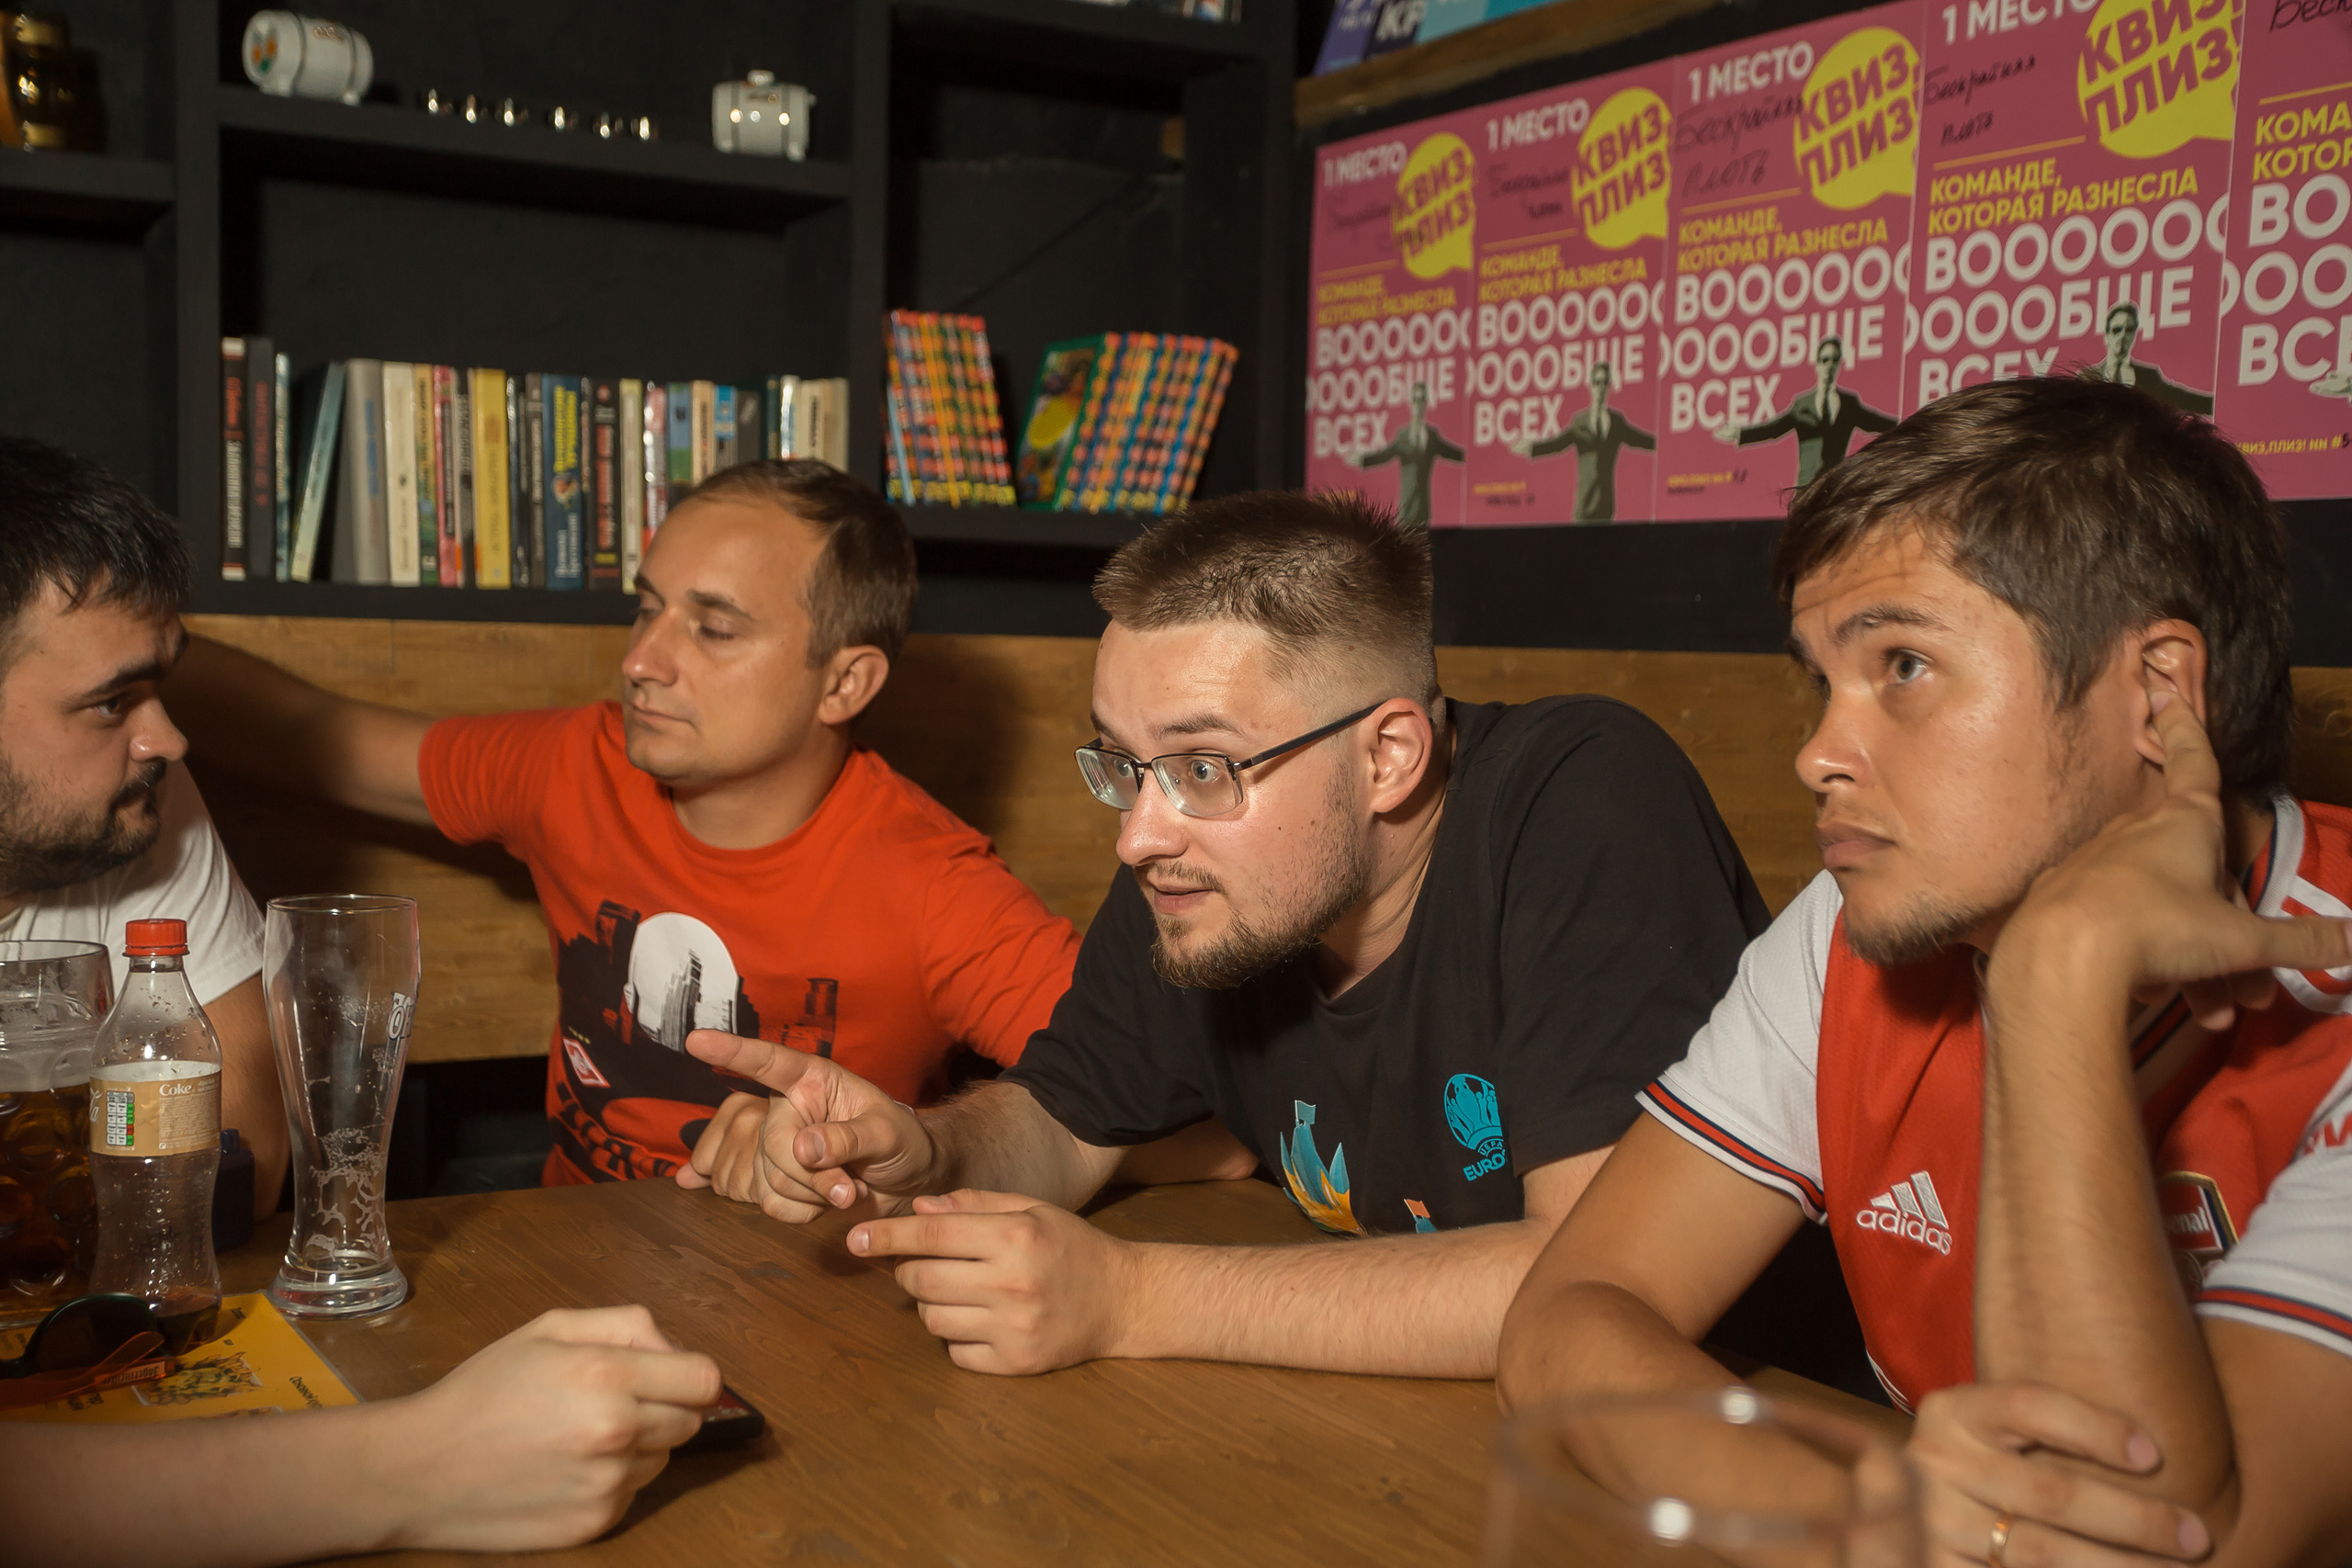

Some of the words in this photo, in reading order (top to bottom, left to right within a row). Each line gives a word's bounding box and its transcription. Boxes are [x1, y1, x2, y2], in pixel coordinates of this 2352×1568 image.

[1942, 5, 1957, 44] 1
[1690, 67, 1702, 103] 1
[1707, 41, 1815, 100] МЕСТО
[1486, 118, 1499, 152] 1
[1501, 97, 1590, 149] МЕСТО
[2256, 100, 2352, 147] КОМА
[1336, 141, 1408, 186] МЕСТО
[1930, 157, 2063, 205] КОМАНДЕ,
[1929, 191, 2045, 235] КОТОРАЯ
[2052, 165, 2199, 217] РАЗНЕСЛА
[1677, 234, 1770, 272] КОТОРАЯ
[1774, 217, 1889, 259] РАЗНЕСЛА
[1679, 205, 1782, 245] КОМАНДЕ,
[1475, 394, 1564, 446] ВСЕХ
[1670, 373, 1781, 433] ВСЕХ
[1314, 411, 1389, 457] ВСЕХ
[159, 1083, 192, 1097] Coke
[1464, 1153, 1506, 1181] EURO
[1480, 1140, 1503, 1156] UEFA
[1857, 1209, 1952, 1256] adidas
